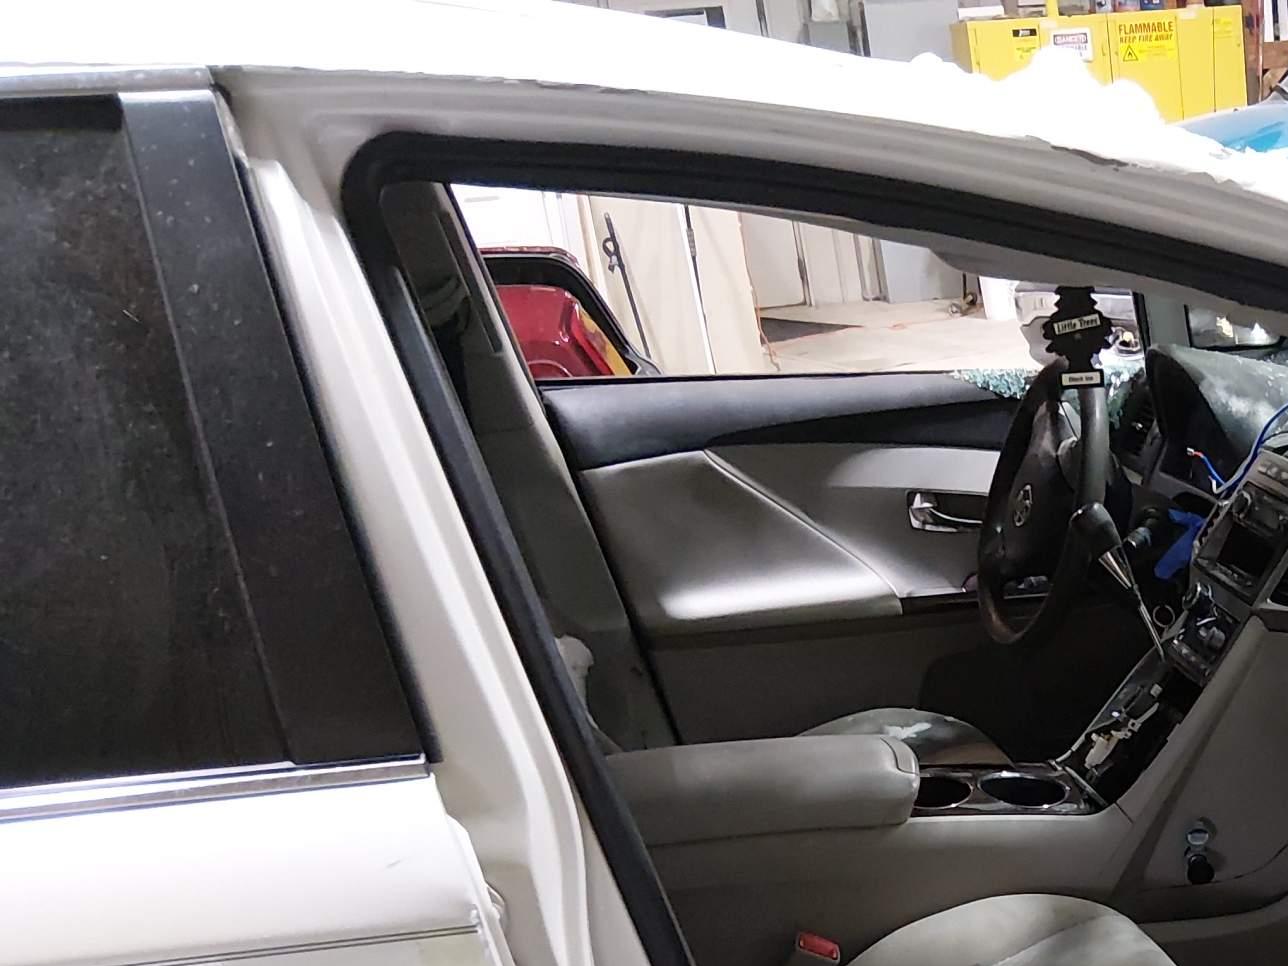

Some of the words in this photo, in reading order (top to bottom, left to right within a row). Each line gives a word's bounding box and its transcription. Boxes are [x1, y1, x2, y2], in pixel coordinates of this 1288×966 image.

[1118, 21, 1174, 35] FLAMMABLE
[1056, 320, 1077, 333] Little
[1079, 317, 1099, 328] Trees
